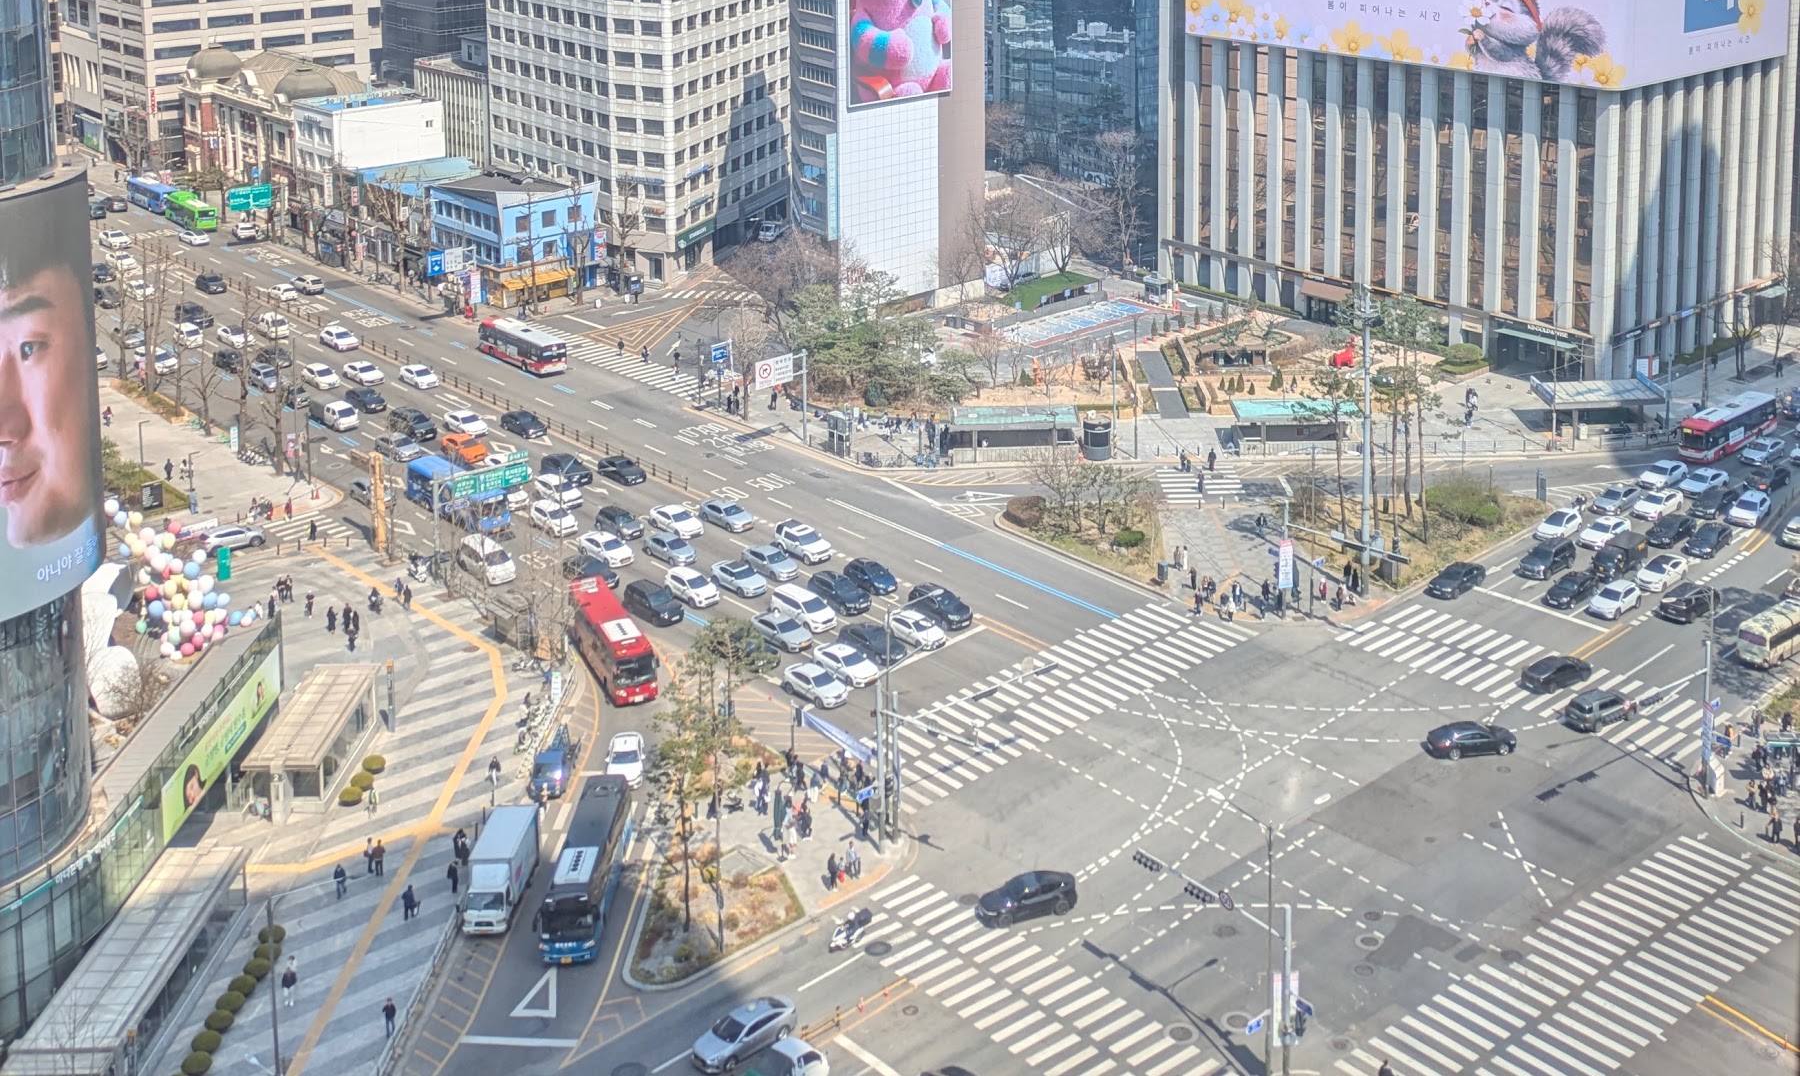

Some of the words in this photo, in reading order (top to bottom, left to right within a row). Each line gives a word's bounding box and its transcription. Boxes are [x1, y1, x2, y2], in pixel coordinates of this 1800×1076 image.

[1327, 0, 1347, 11] 봄이
[1359, 3, 1406, 18] 피어나는
[1419, 10, 1440, 22] 시간
[745, 476, 784, 492] 50
[710, 486, 750, 502] 50
[37, 553, 73, 581] 아니야
[74, 545, 84, 565] 잘
